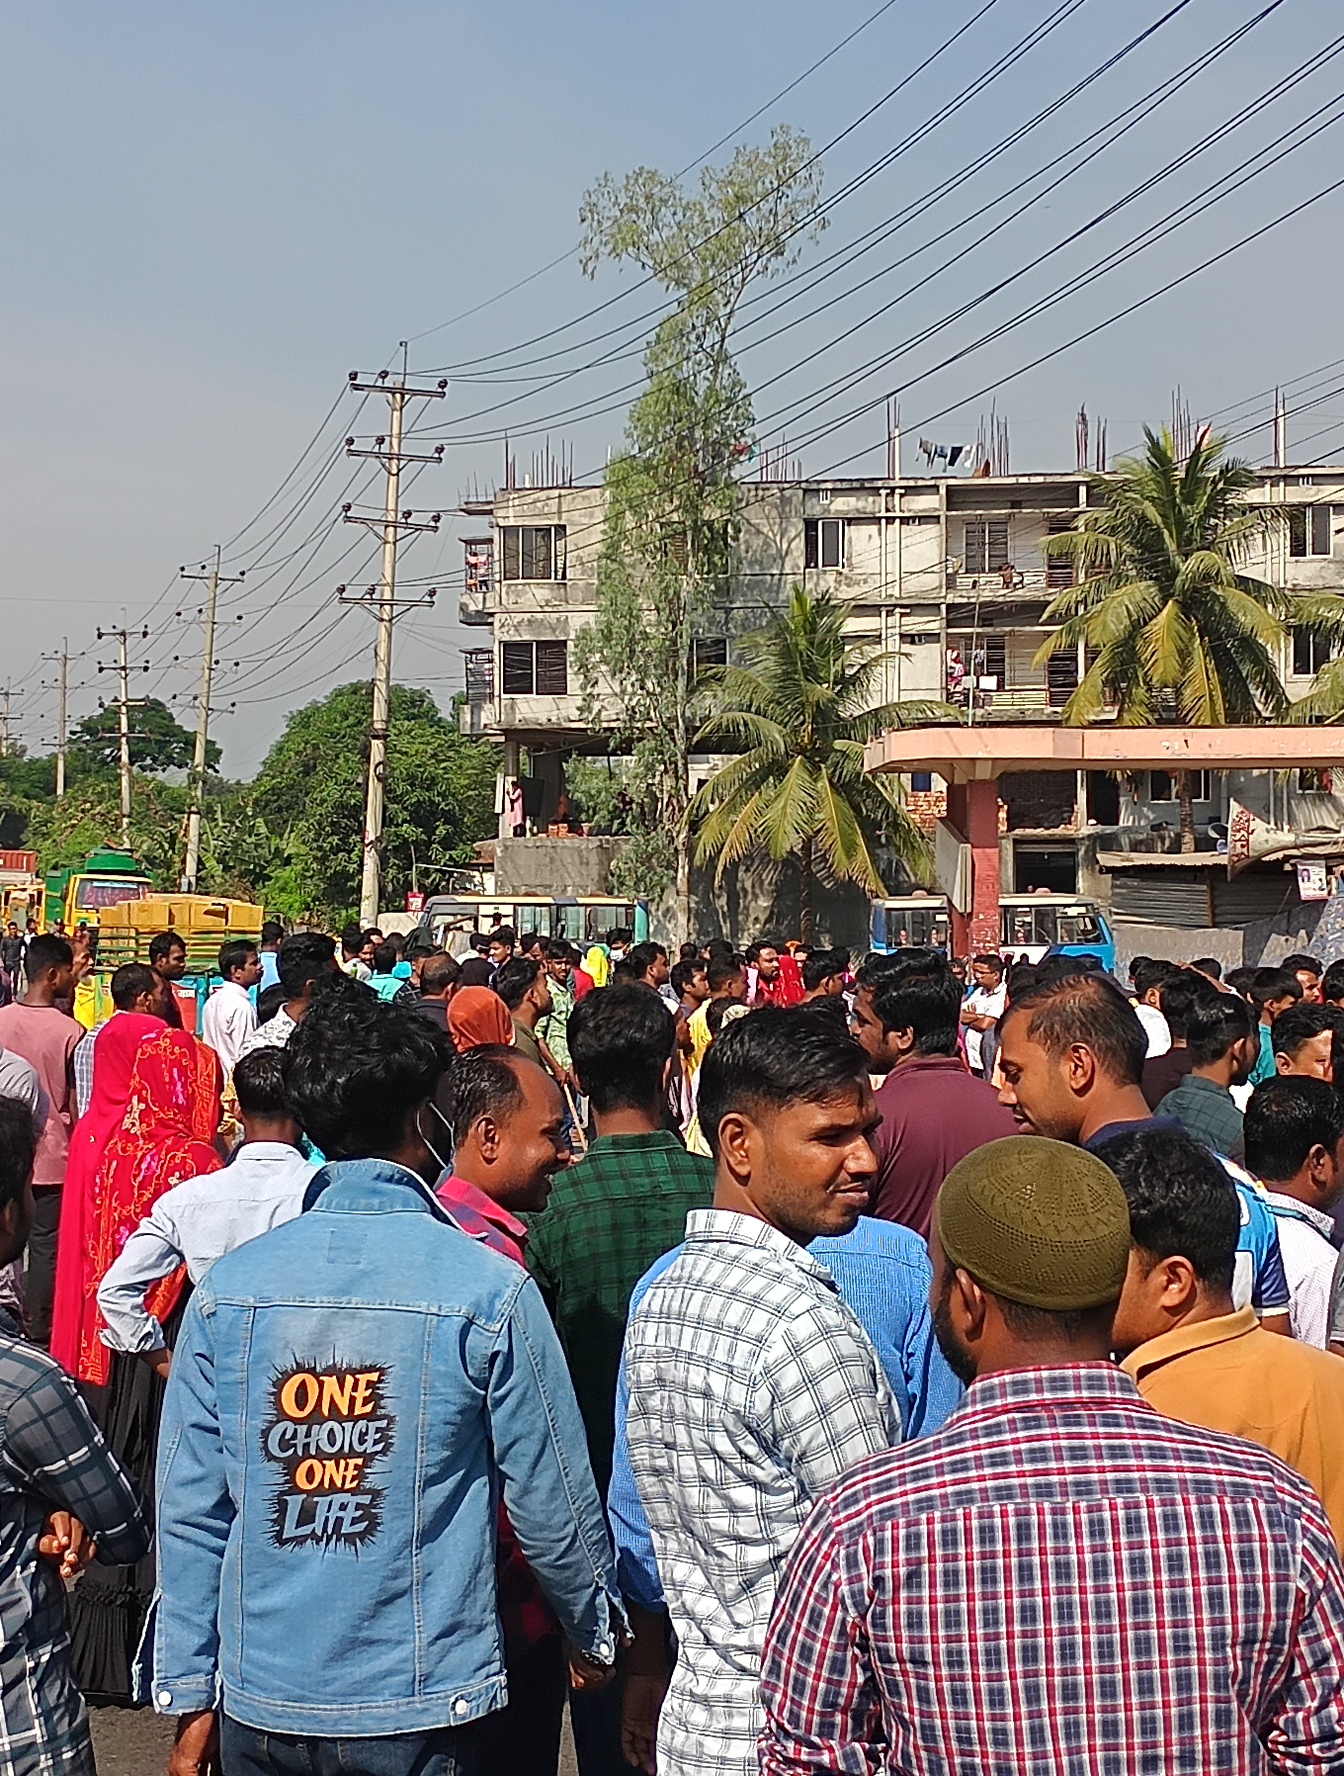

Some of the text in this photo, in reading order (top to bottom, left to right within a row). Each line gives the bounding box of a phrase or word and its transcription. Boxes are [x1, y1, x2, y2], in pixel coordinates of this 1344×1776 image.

[280, 1371, 381, 1419] ONE
[267, 1418, 389, 1459] CHOICE
[294, 1457, 365, 1491] ONE
[282, 1492, 373, 1539] LIFE
